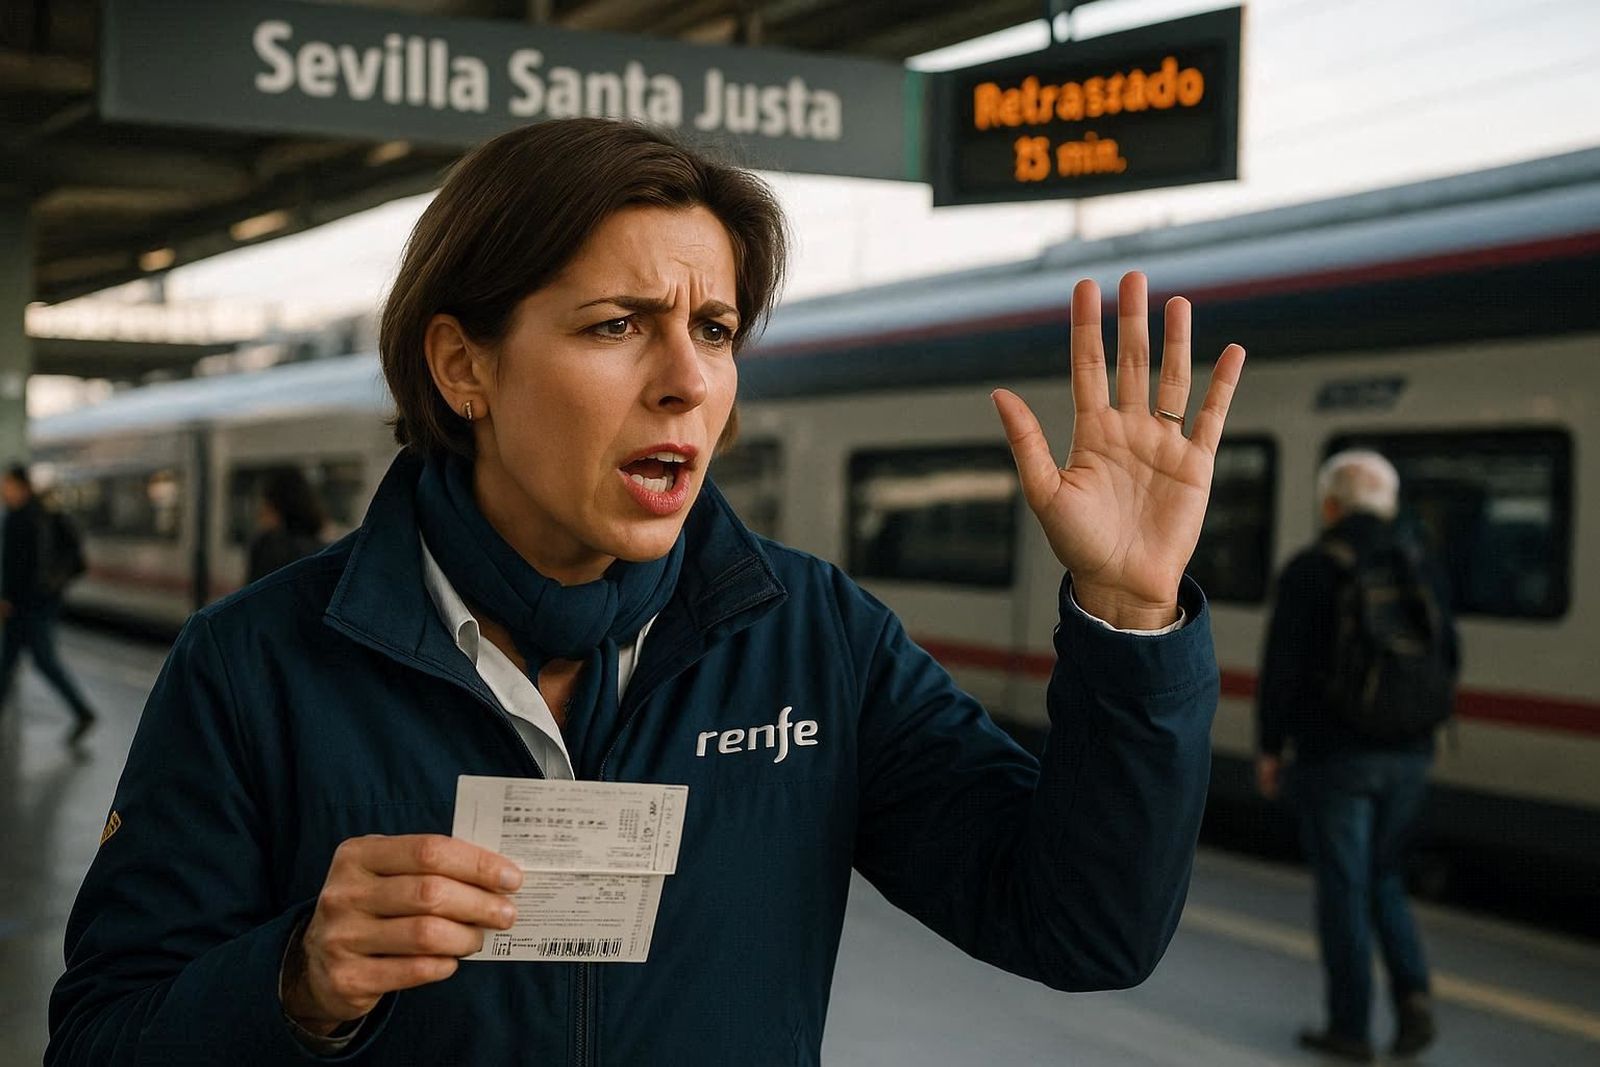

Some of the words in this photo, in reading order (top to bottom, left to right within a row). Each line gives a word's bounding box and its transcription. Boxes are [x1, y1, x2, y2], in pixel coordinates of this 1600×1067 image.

[253, 20, 489, 113] Sevilla
[508, 49, 683, 128] Santa
[695, 67, 842, 141] Justa
[696, 706, 818, 763] renfe
